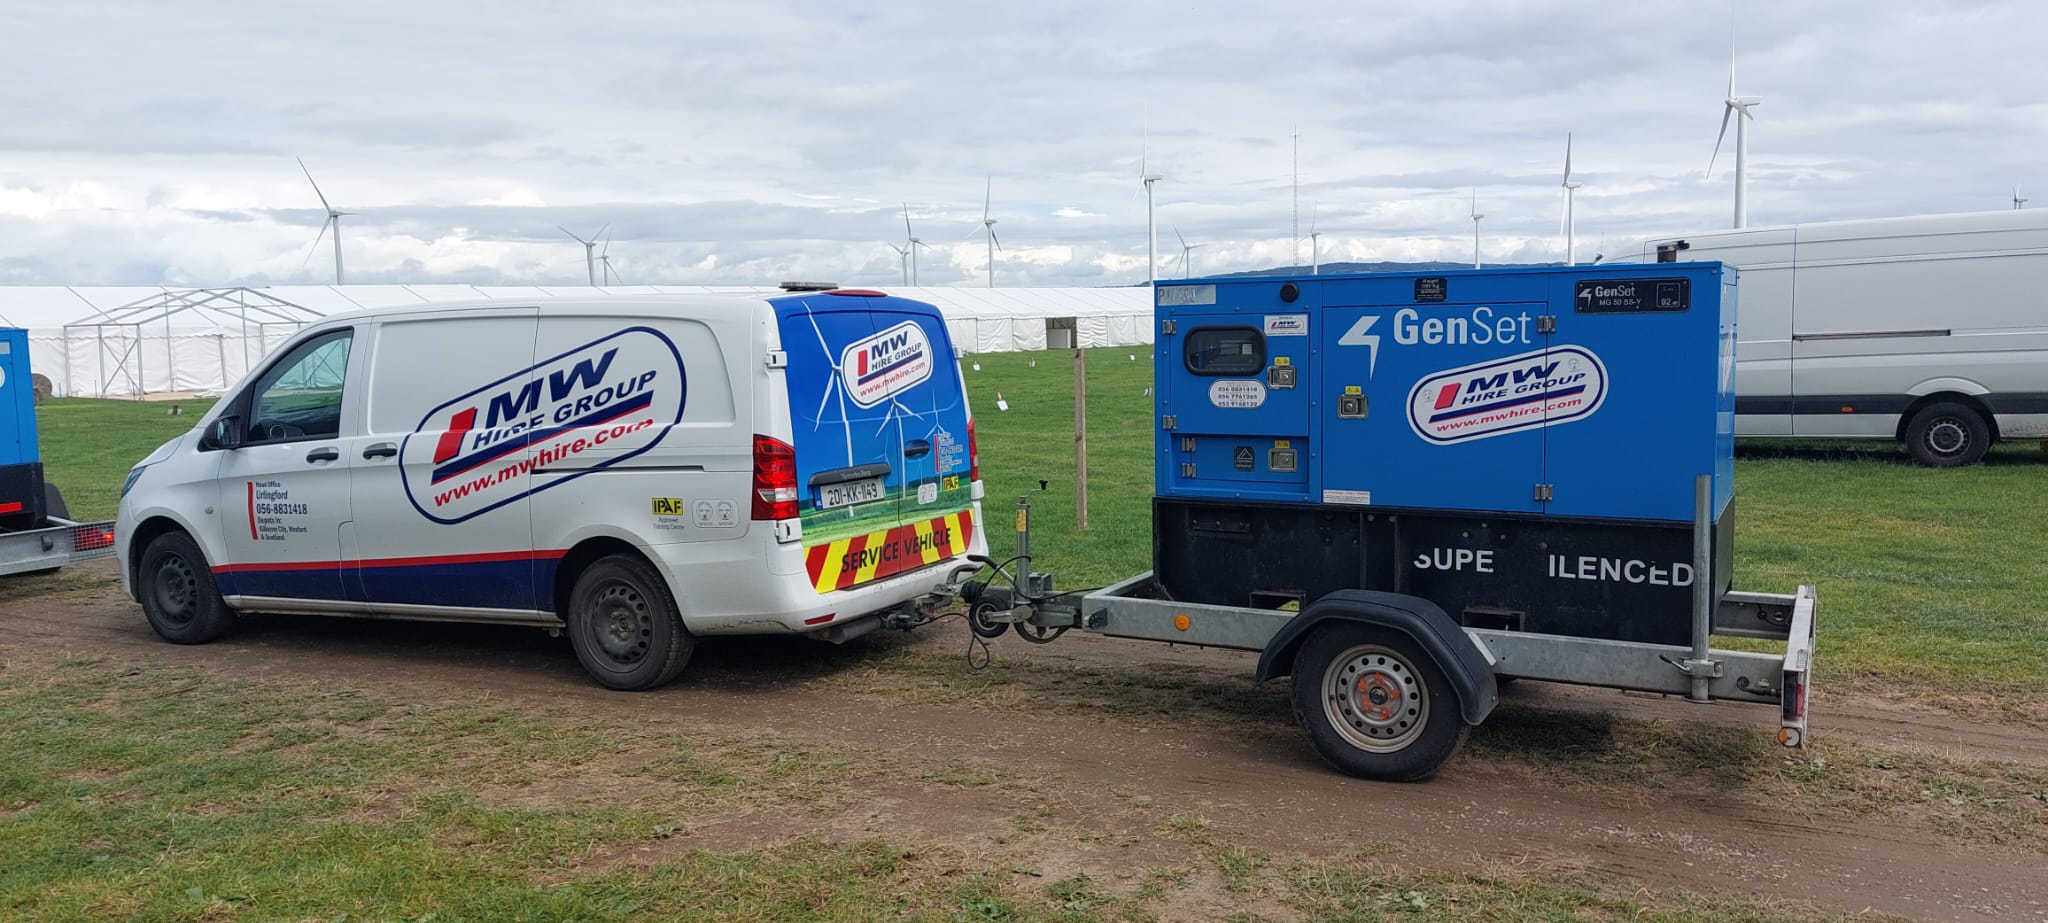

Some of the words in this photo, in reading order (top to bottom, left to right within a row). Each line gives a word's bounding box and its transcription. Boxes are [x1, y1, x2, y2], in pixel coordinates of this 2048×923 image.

[1595, 285, 1635, 297] GenSet
[1661, 298, 1672, 306] 92
[1393, 306, 1532, 345] GenSet
[871, 331, 908, 360] MW
[871, 355, 893, 371] HIRE
[894, 342, 922, 360] GROUP
[485, 347, 619, 430] MW
[860, 362, 926, 397] www.mwhire.com
[1461, 388, 1509, 406] HIRE
[1514, 373, 1587, 394] GROUP
[1466, 361, 1561, 394] MW
[472, 413, 545, 450] HIRE
[553, 370, 657, 424] GROUP
[1436, 398, 1583, 432] www.mwhire.com
[434, 418, 654, 507] www.mwhire.com
[256, 490, 288, 502] Urlingford
[828, 483, 878, 506] 201-KK-1149
[944, 477, 958, 490] IPAF
[256, 503, 308, 515] 056-8831418
[653, 497, 681, 513] IPAF
[257, 516, 275, 524] Depots
[841, 541, 899, 573] SERVICE
[904, 528, 951, 556] VEHICLE
